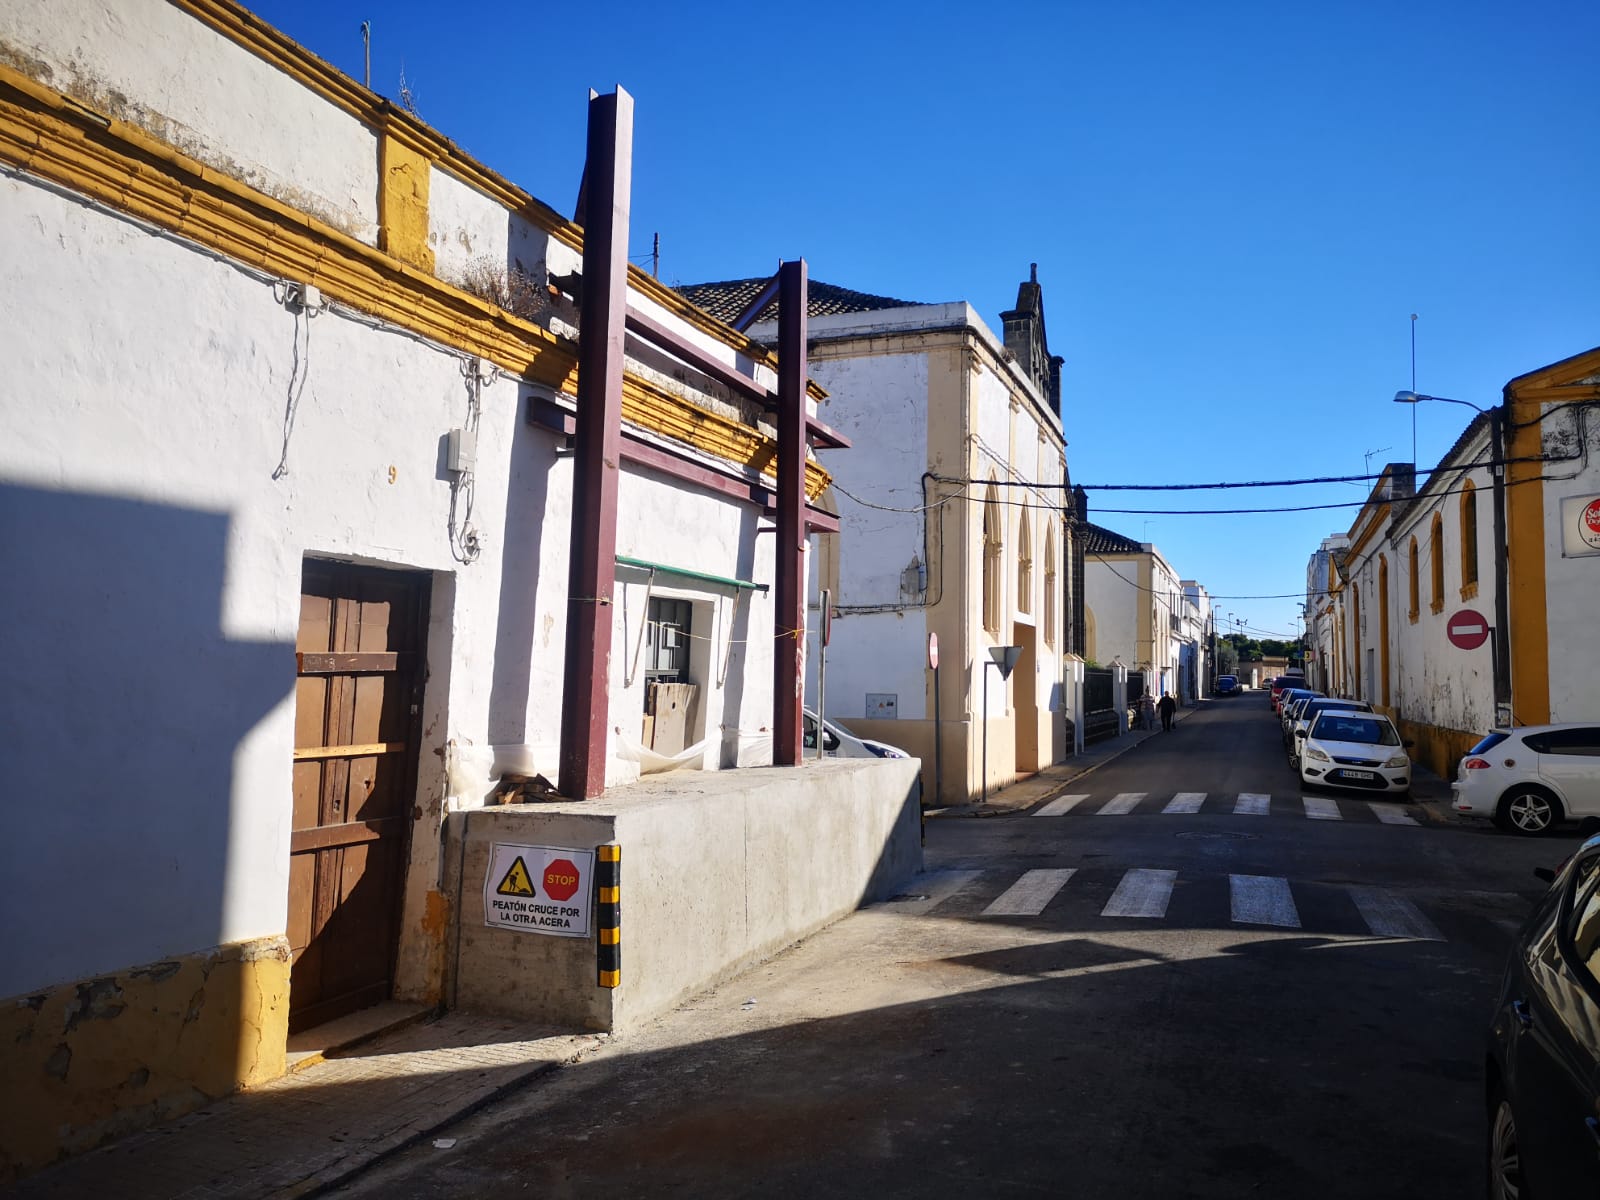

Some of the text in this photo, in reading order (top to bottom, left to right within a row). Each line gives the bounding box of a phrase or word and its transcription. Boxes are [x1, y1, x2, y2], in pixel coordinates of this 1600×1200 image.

[388, 464, 397, 485] 9
[547, 874, 576, 886] STOP
[492, 900, 580, 917] PEATÓN CRUCE POR
[500, 911, 511, 921] LA
[512, 913, 537, 925] OTRA
[538, 916, 571, 928] ACERA
